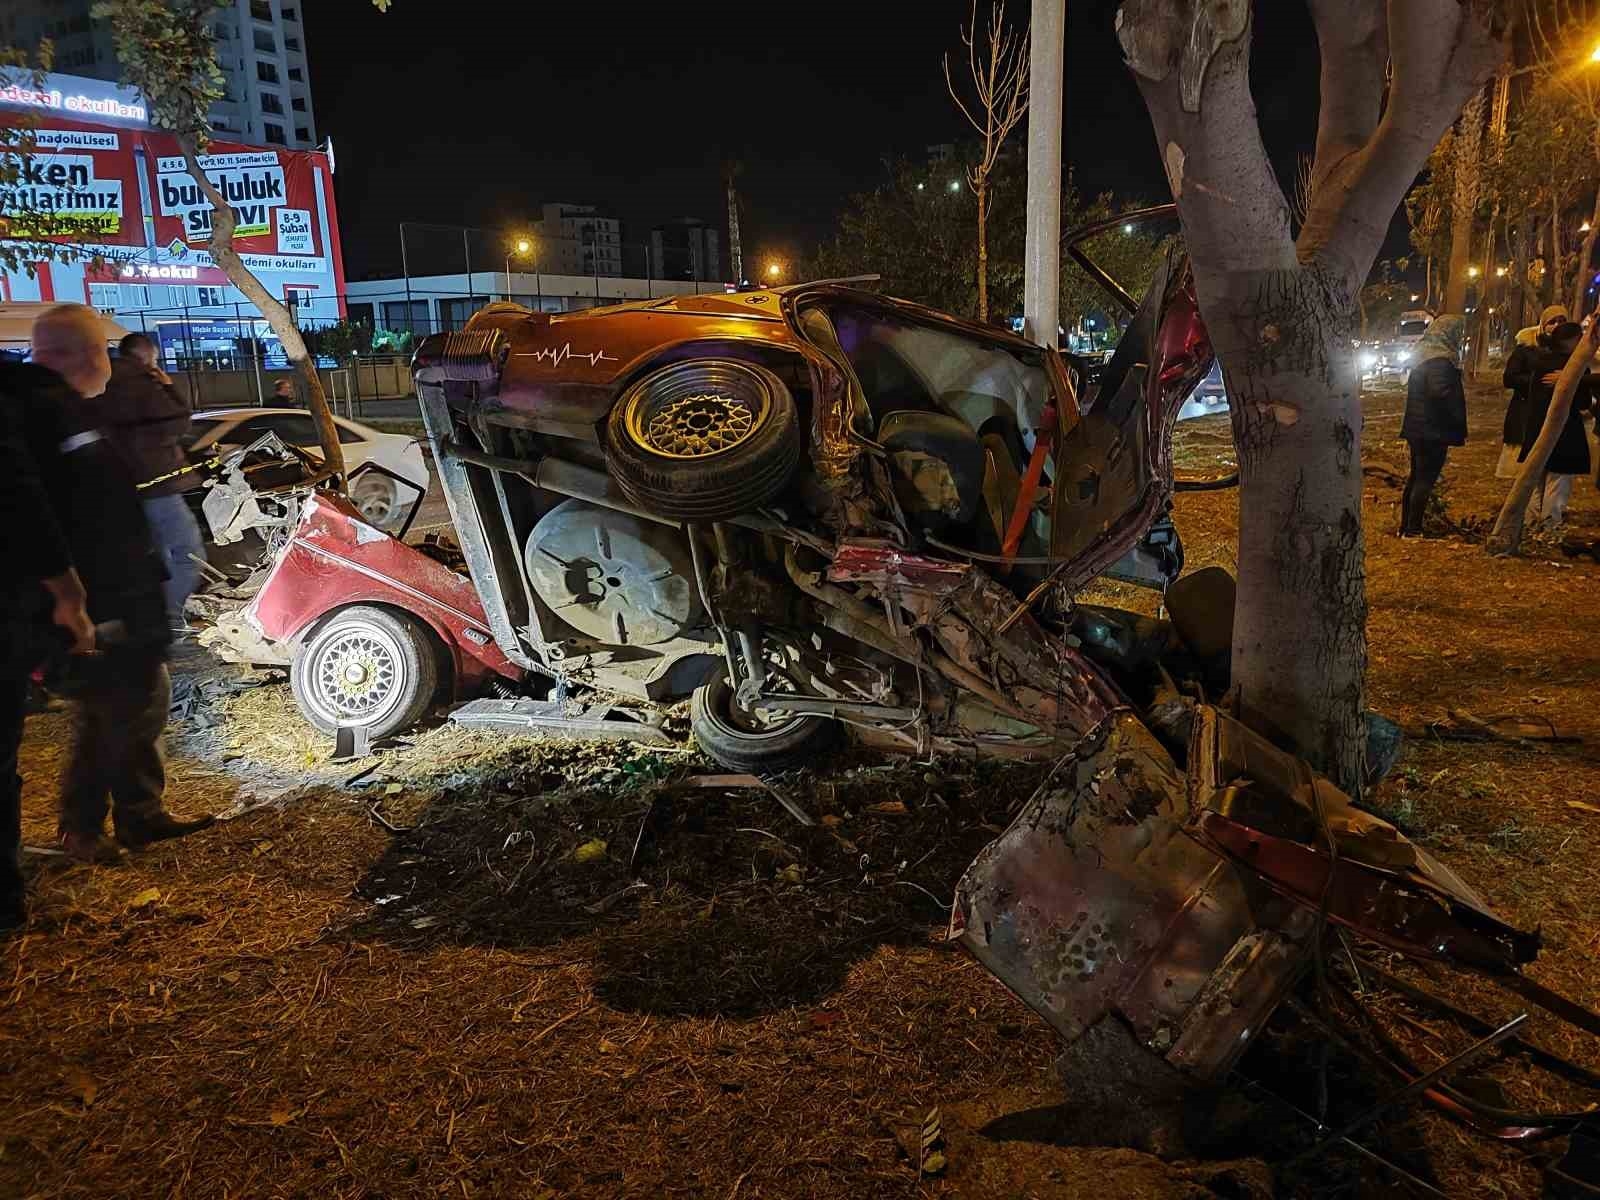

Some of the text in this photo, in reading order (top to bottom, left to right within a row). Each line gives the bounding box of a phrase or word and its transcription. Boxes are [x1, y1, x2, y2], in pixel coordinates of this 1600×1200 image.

[83, 135, 115, 146] Lisesi
[189, 204, 266, 231] sıvı
[275, 259, 317, 269] okulları
